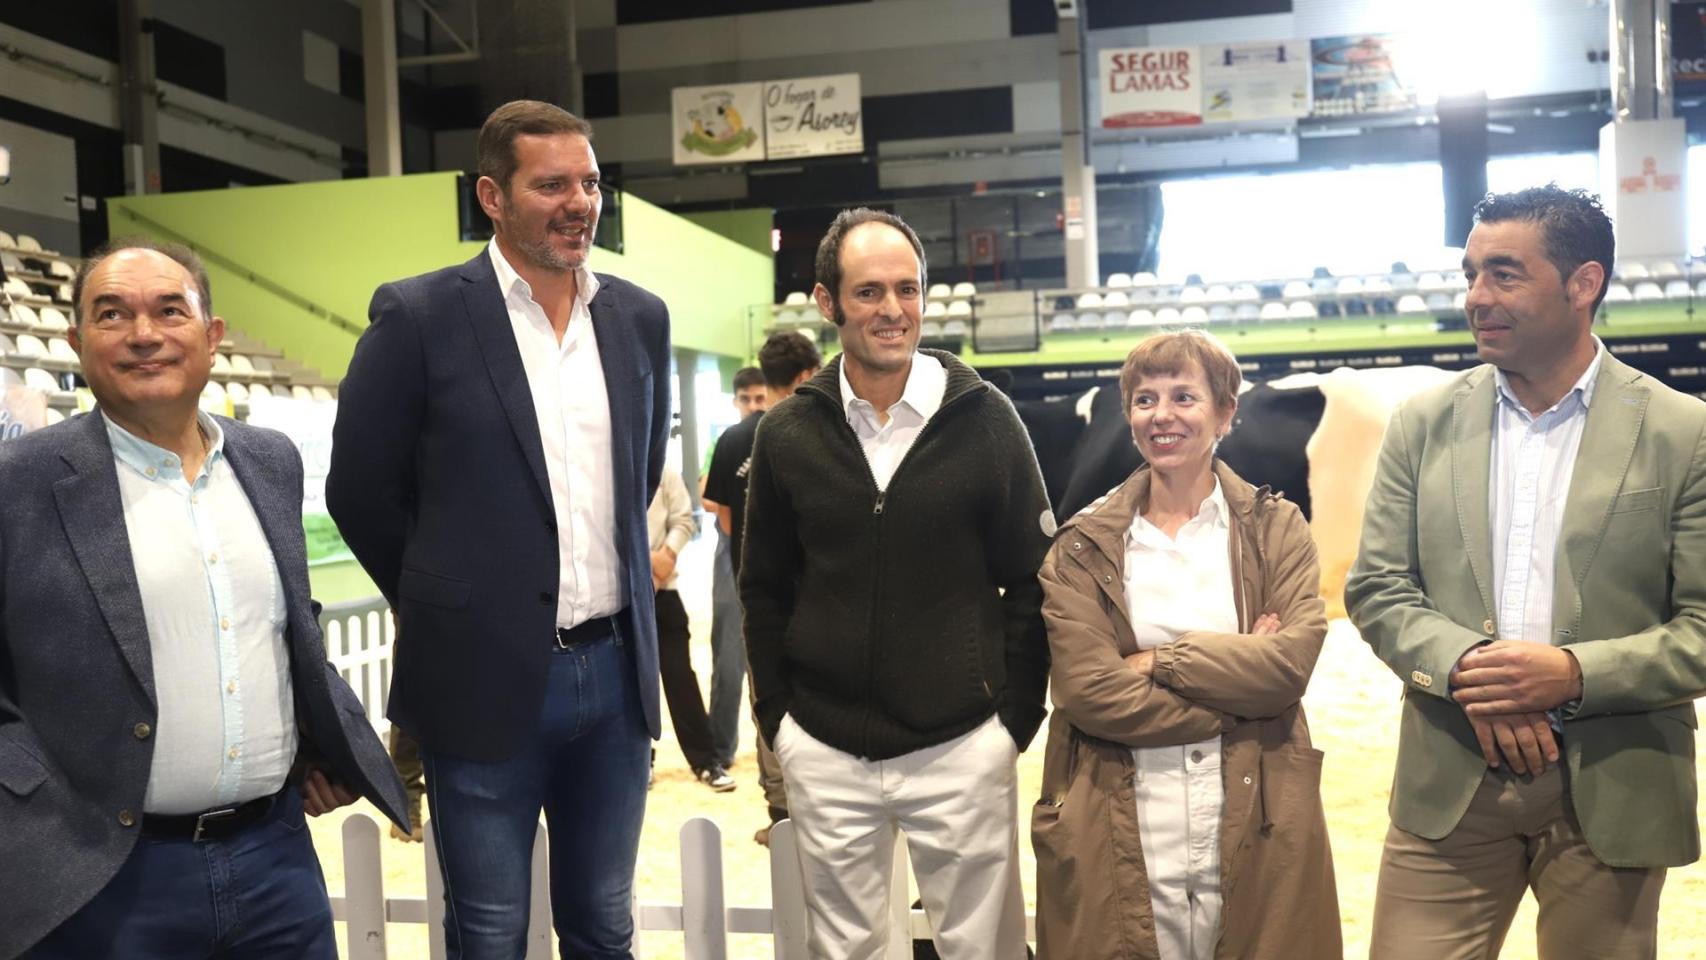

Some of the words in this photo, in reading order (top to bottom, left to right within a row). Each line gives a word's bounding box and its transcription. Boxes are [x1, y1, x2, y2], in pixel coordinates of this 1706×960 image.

[1111, 51, 1189, 74] SEGUR
[1110, 73, 1189, 93] LAMAS
[768, 84, 781, 107] O
